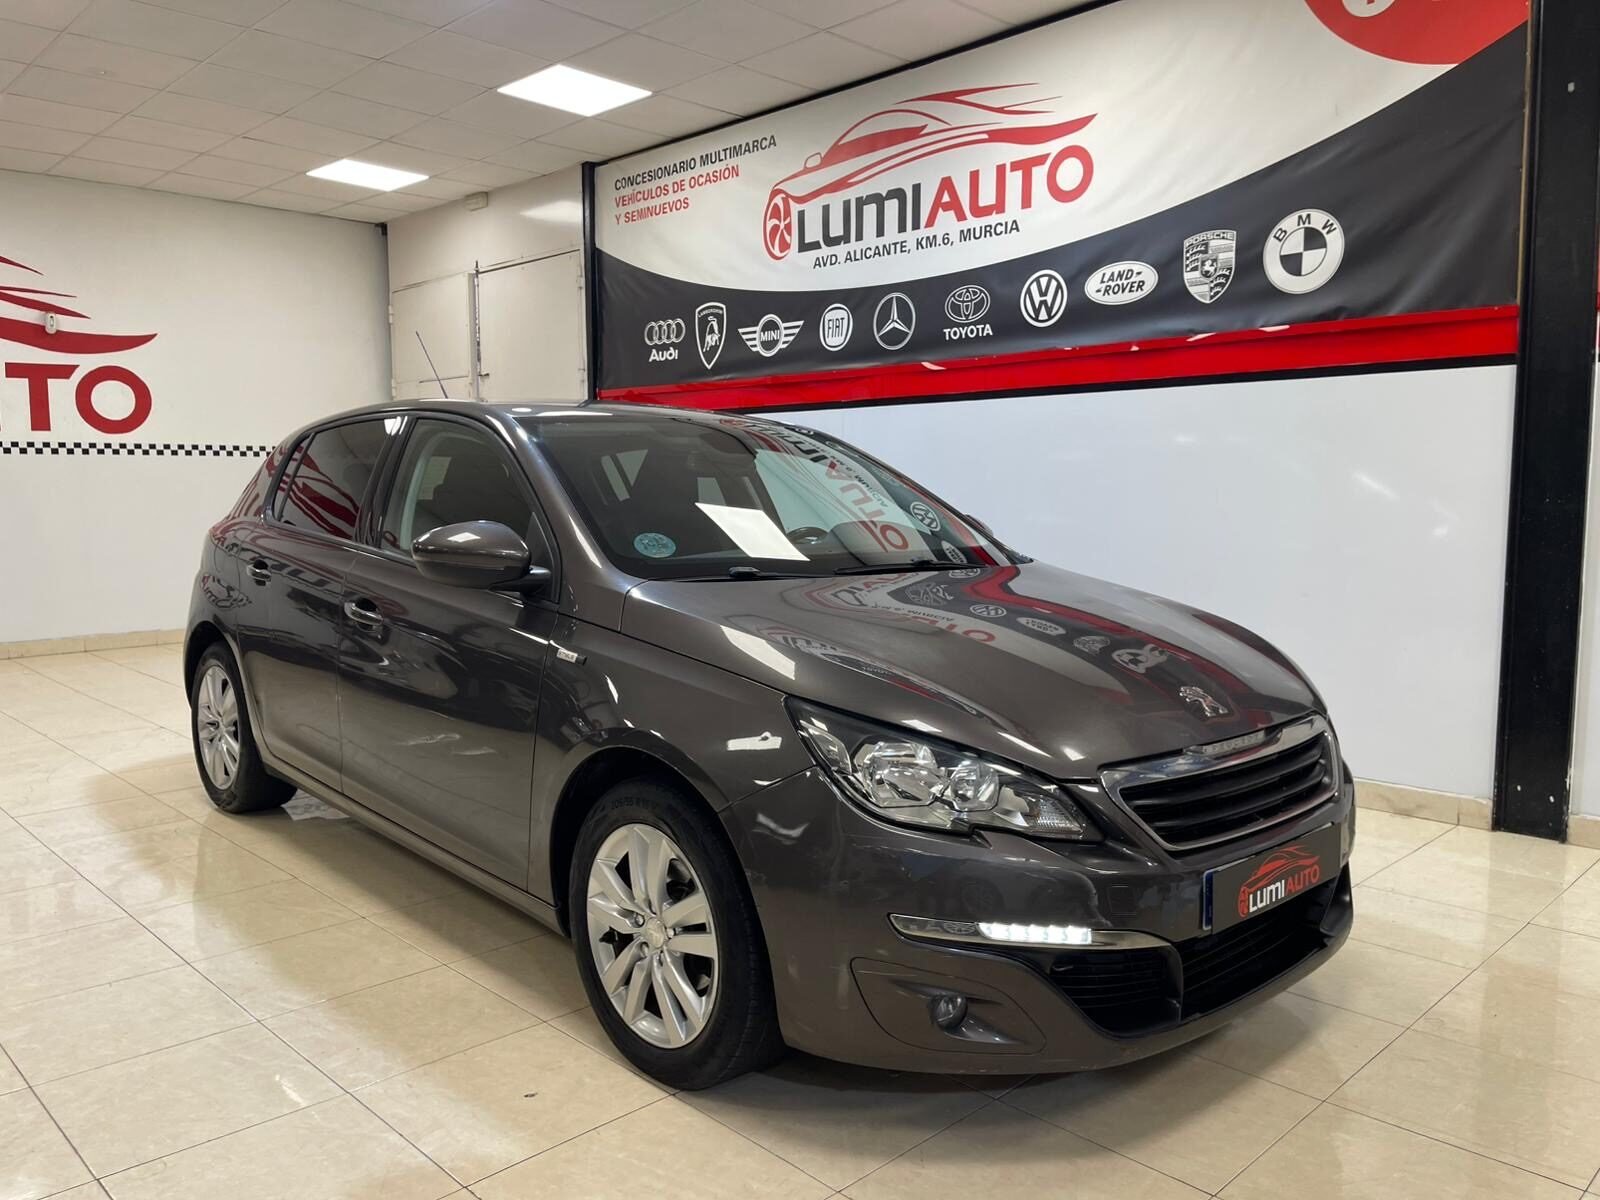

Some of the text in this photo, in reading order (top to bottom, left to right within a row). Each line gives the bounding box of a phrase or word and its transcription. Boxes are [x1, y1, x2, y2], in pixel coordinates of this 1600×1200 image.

[614, 134, 777, 191] CONCESIONARIO MULTIMARCA
[614, 163, 740, 208] VEHÍCULOS DE OCASIÓN
[615, 197, 690, 225] Y SEMINUEVOS
[1185, 231, 1235, 248] PORSCHE
[1273, 213, 1337, 243] BMW
[813, 219, 1020, 270] AVD. ALICANTE, KM.6, MURCIA
[760, 329, 780, 342] MINI
[827, 317, 845, 339] FIAT
[943, 324, 993, 341] TOYOTA
[649, 347, 679, 362] Audi
[0, 362, 152, 434] TO
